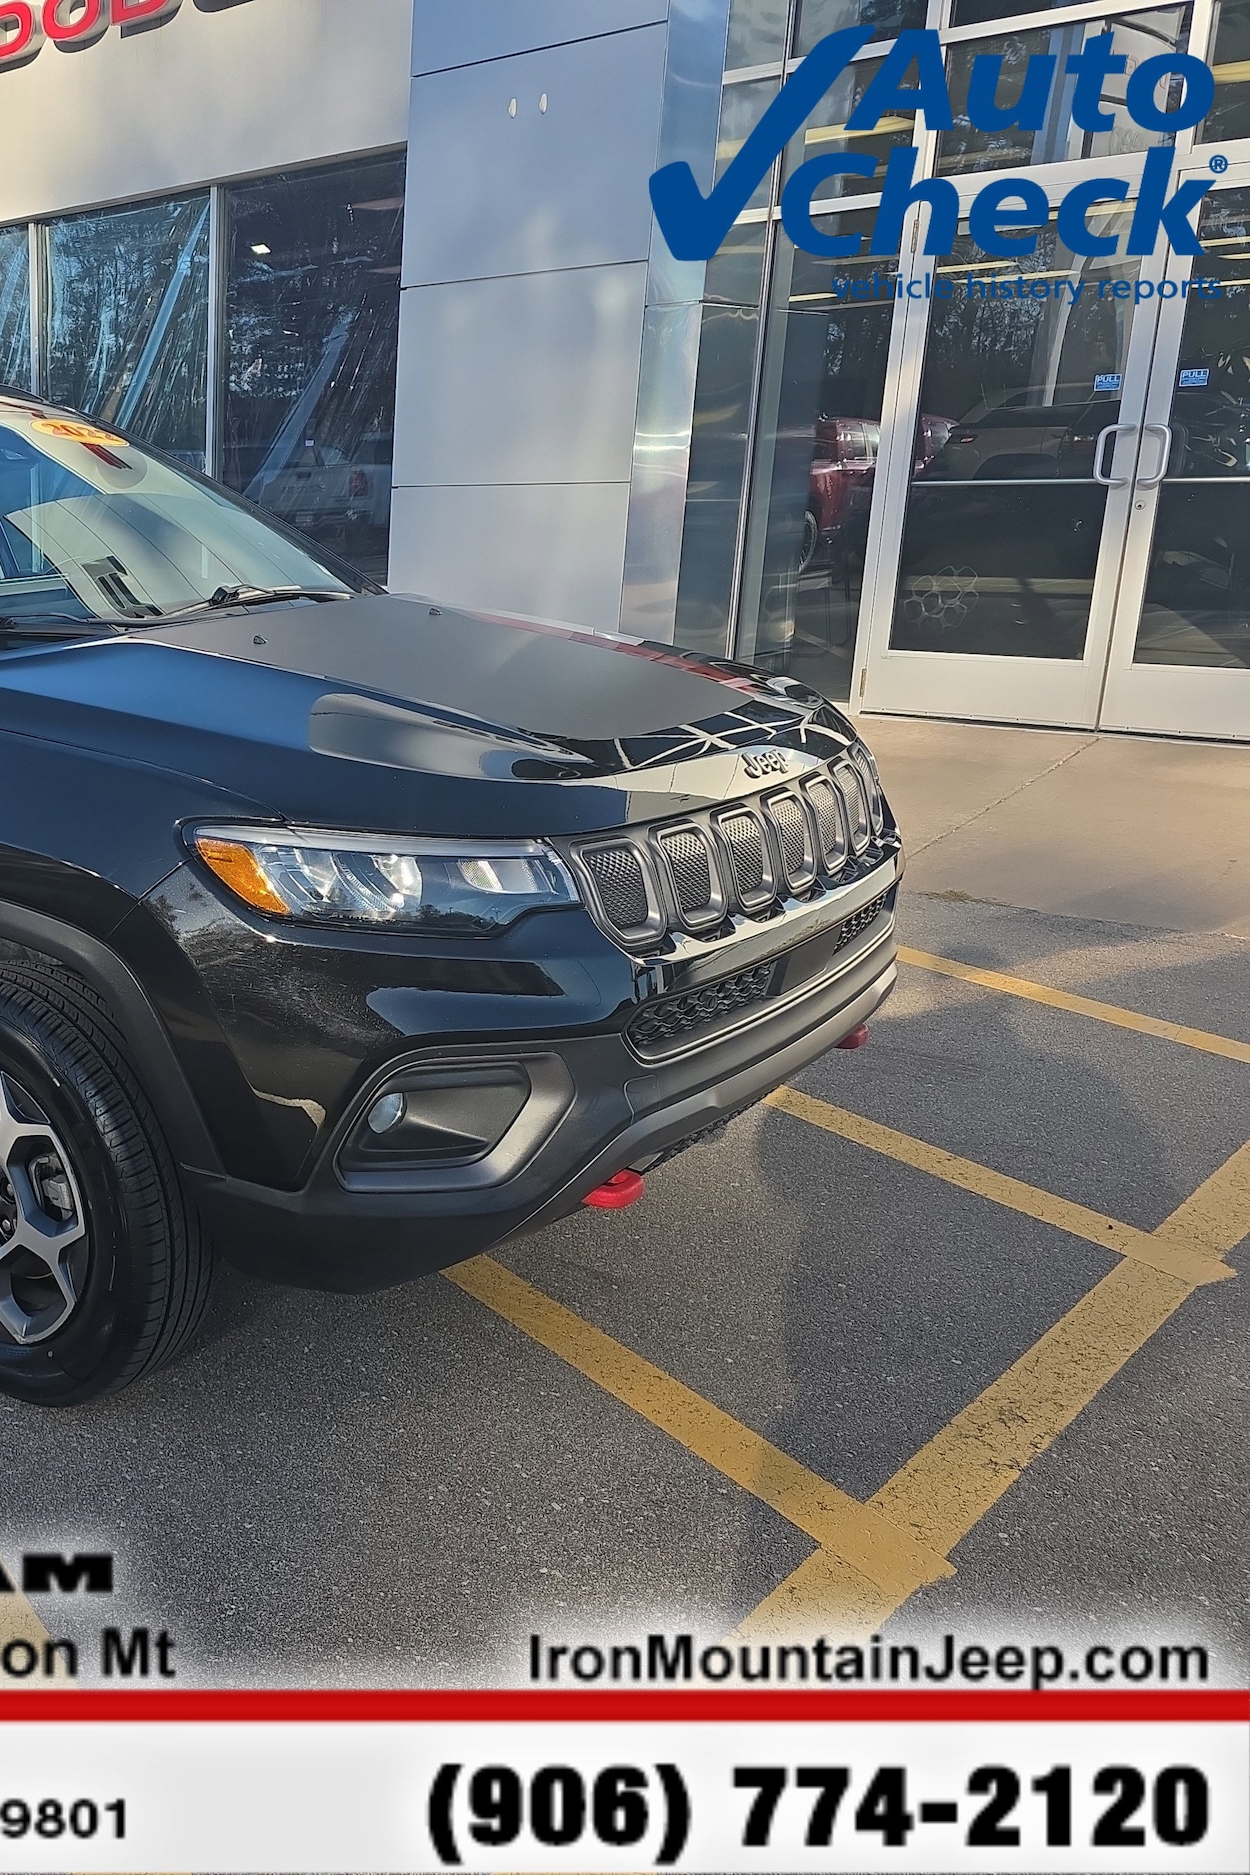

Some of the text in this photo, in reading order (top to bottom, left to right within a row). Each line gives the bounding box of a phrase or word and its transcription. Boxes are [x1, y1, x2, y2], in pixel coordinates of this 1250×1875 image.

[1096, 374, 1120, 383] PULL
[1182, 370, 1207, 378] PULL
[741, 749, 789, 778] Jeep
